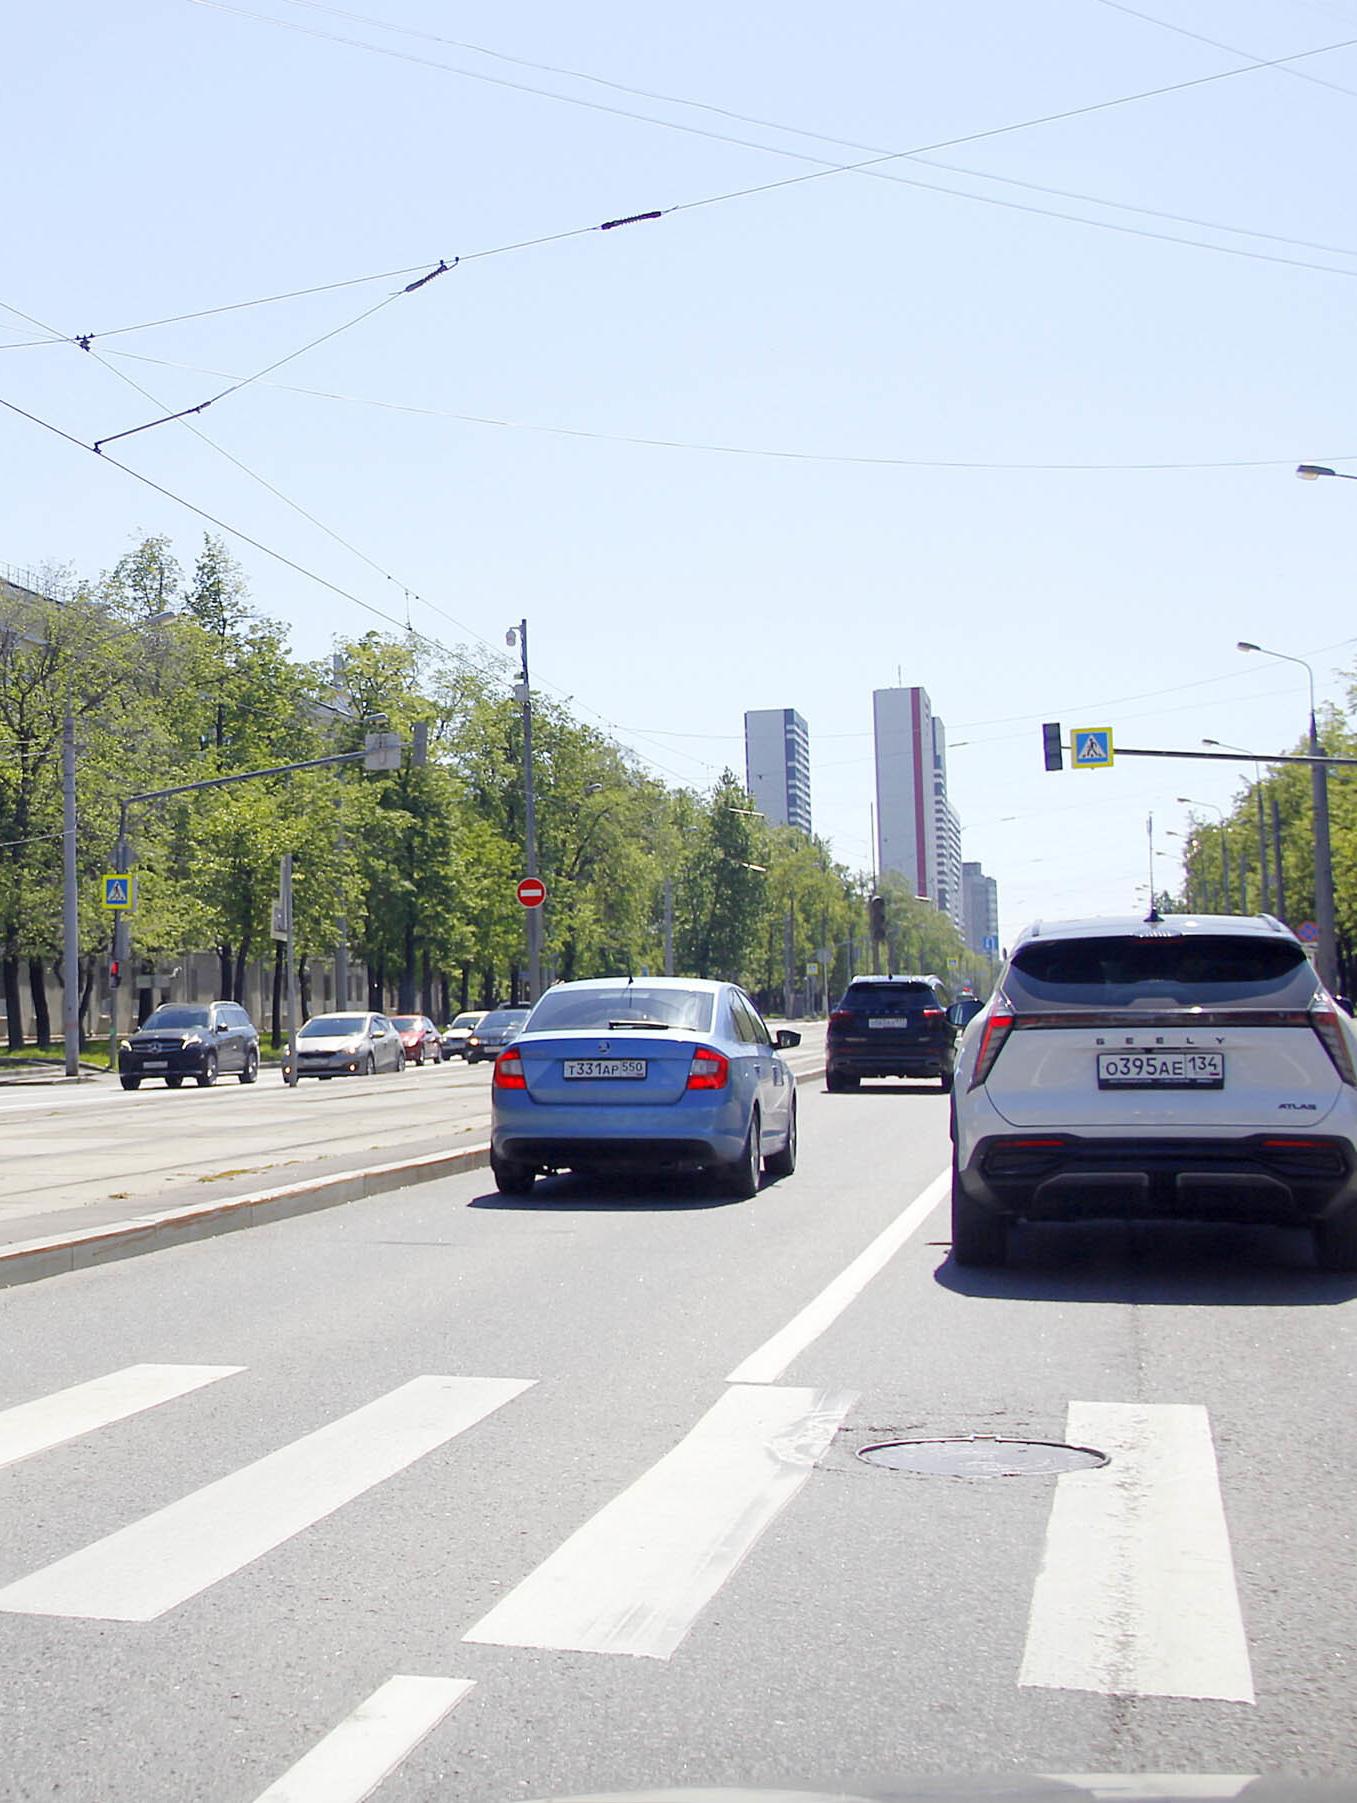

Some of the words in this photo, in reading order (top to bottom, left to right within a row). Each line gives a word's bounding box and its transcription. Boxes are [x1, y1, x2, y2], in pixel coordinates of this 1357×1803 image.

[1095, 1036, 1225, 1045] GEELY
[622, 1061, 643, 1073] 550
[1187, 1056, 1218, 1071] 134
[1278, 1103, 1318, 1111] ATLAS
